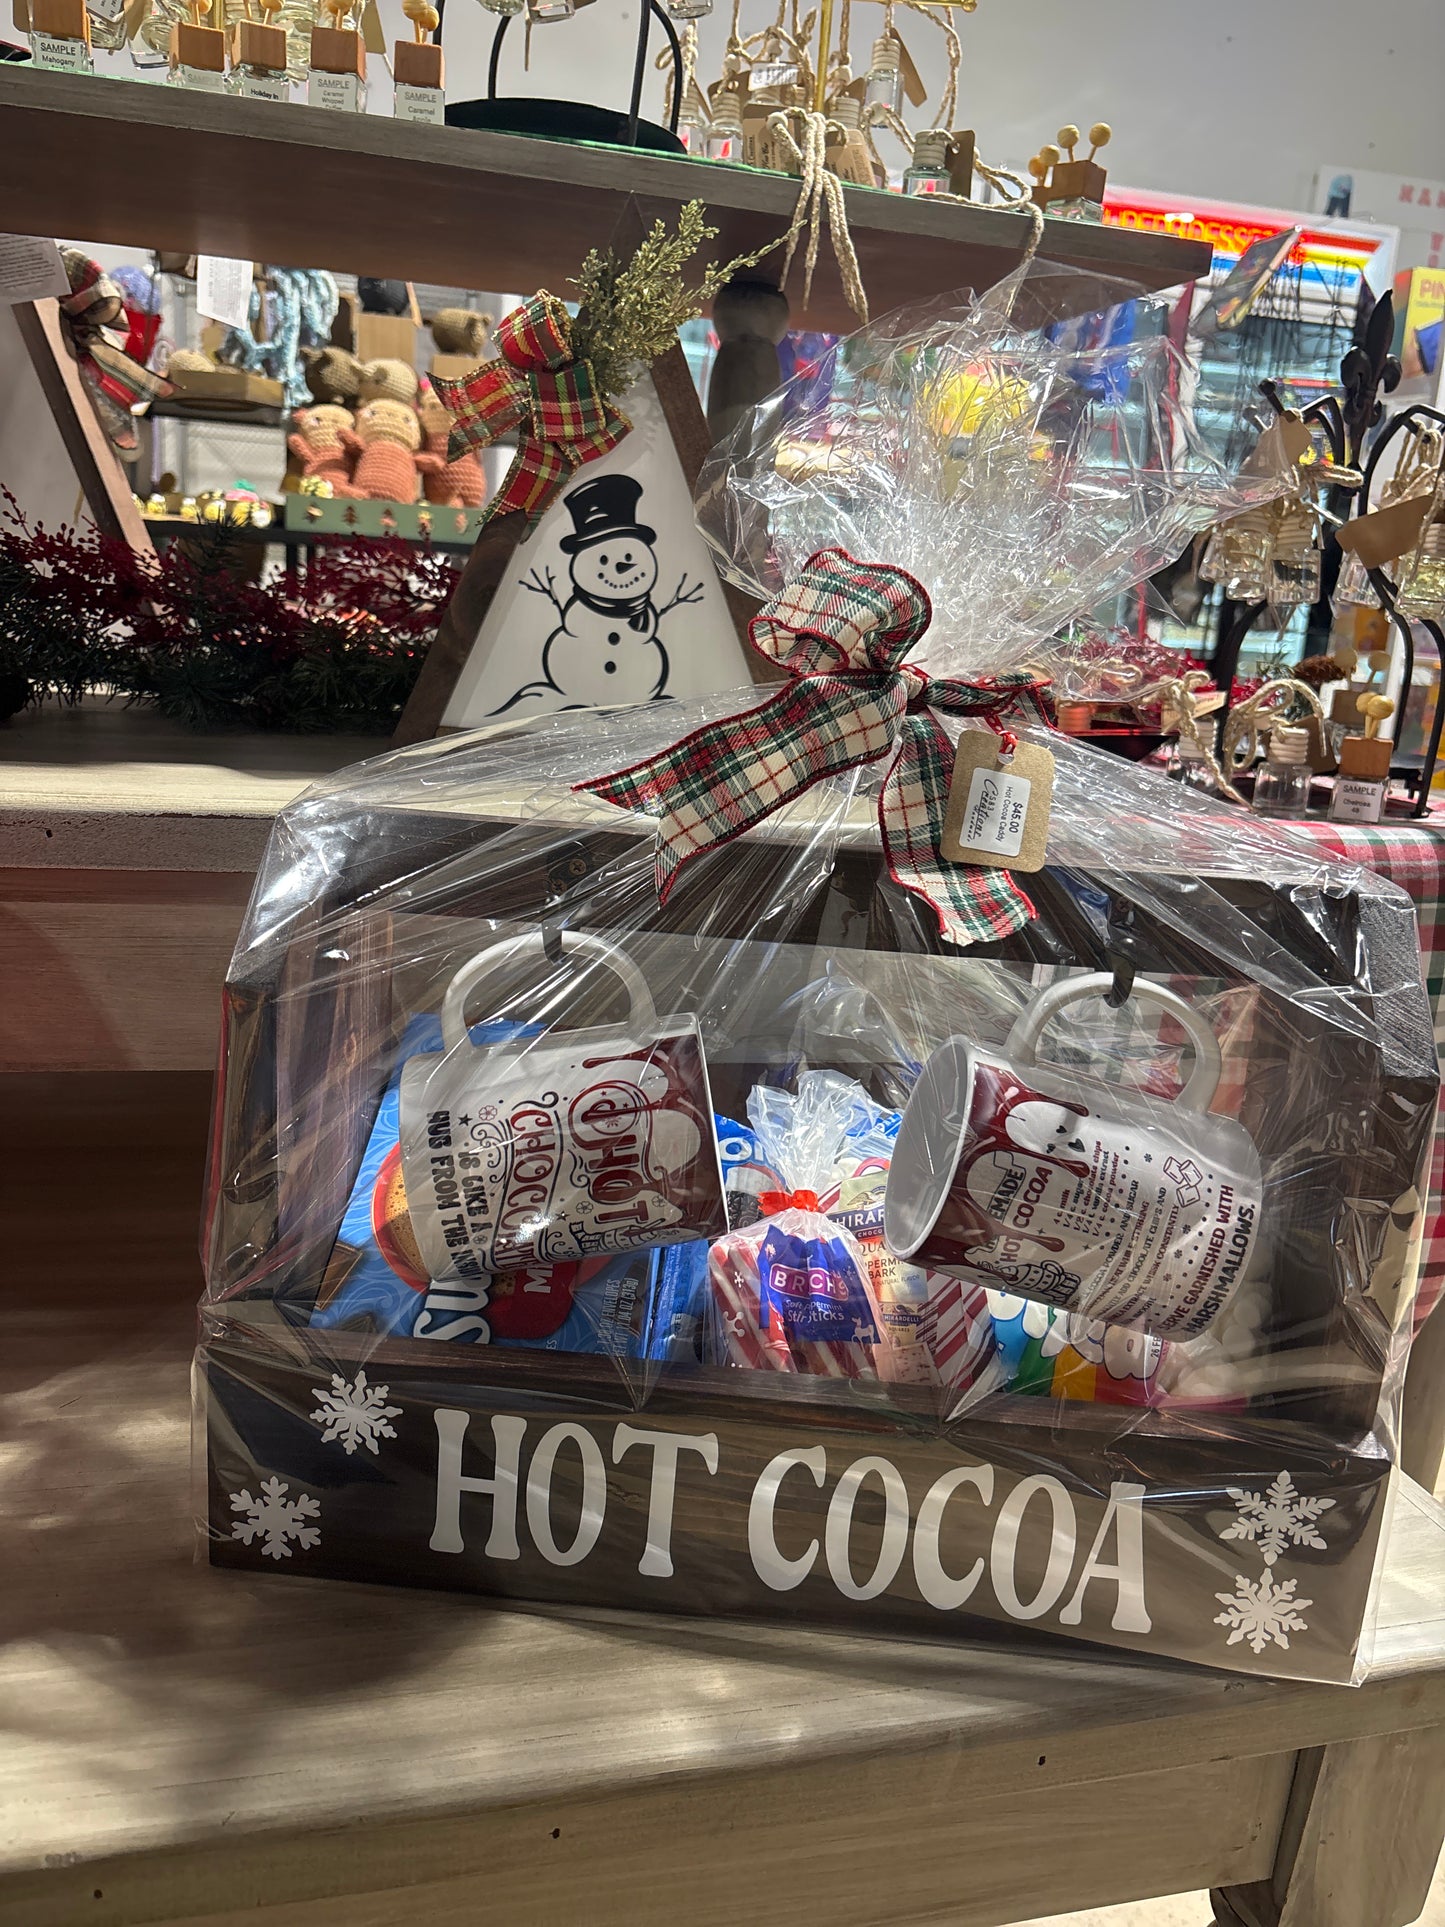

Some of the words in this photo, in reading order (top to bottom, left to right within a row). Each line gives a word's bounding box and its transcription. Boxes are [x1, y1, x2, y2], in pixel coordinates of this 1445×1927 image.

[40, 42, 76, 56] SAMPLE
[42, 55, 75, 67] Mahogany
[251, 89, 272, 99] Holiday
[318, 78, 350, 89] SAMPLE
[404, 91, 436, 103] SAMPLE
[408, 106, 435, 115] Caramel
[1343, 785, 1377, 796] SAMPLE
[974, 778, 999, 839] Creations
[1001, 800, 1011, 822] Cocoa
[1010, 802, 1024, 834] $45.00
[996, 822, 1008, 842] Caddy
[427, 1110, 452, 1150] HUG
[457, 1149, 481, 1170] IS
[1082, 1165, 1098, 1206] chocolate
[1092, 1140, 1102, 1163] chips
[430, 1154, 461, 1211] FROM
[587, 1133, 649, 1222] HOT
[1073, 1177, 1085, 1204] sugar
[1092, 1182, 1104, 1211] vanilla
[1099, 1150, 1109, 1181] extract
[1102, 1187, 1114, 1213] cocoa
[1108, 1152, 1119, 1186] powder
[461, 1175, 489, 1217] LIKE
[1012, 1166, 1053, 1229] COCOA
[1059, 1188, 1070, 1209] milk
[1126, 1179, 1139, 1210] SUGAR
[441, 1213, 470, 1248] THE
[470, 1222, 493, 1233] A
[857, 1228, 883, 1238] CHOCO
[1120, 1210, 1133, 1231] AND
[1129, 1235, 1154, 1283] CHOCOLATE
[1158, 1187, 1168, 1206] AND
[1155, 1203, 1180, 1260] CONSTANTLY
[1104, 1233, 1124, 1269] POWDER
[1157, 1305, 1190, 1330] SERVE
[1183, 1227, 1226, 1305] GARNISHED
[1216, 1184, 1234, 1223] WITH
[869, 1267, 896, 1280] BARK
[1184, 1204, 1256, 1333] MARSHMALLOWS.
[602, 1279, 621, 1316] ENVELOPES
[619, 1300, 634, 1311] OZ
[788, 1310, 807, 1323] Stir
[884, 1314, 920, 1322] HIRARDELLI
[429, 1408, 719, 1577] HOT
[748, 1445, 1152, 1634] COCOA
